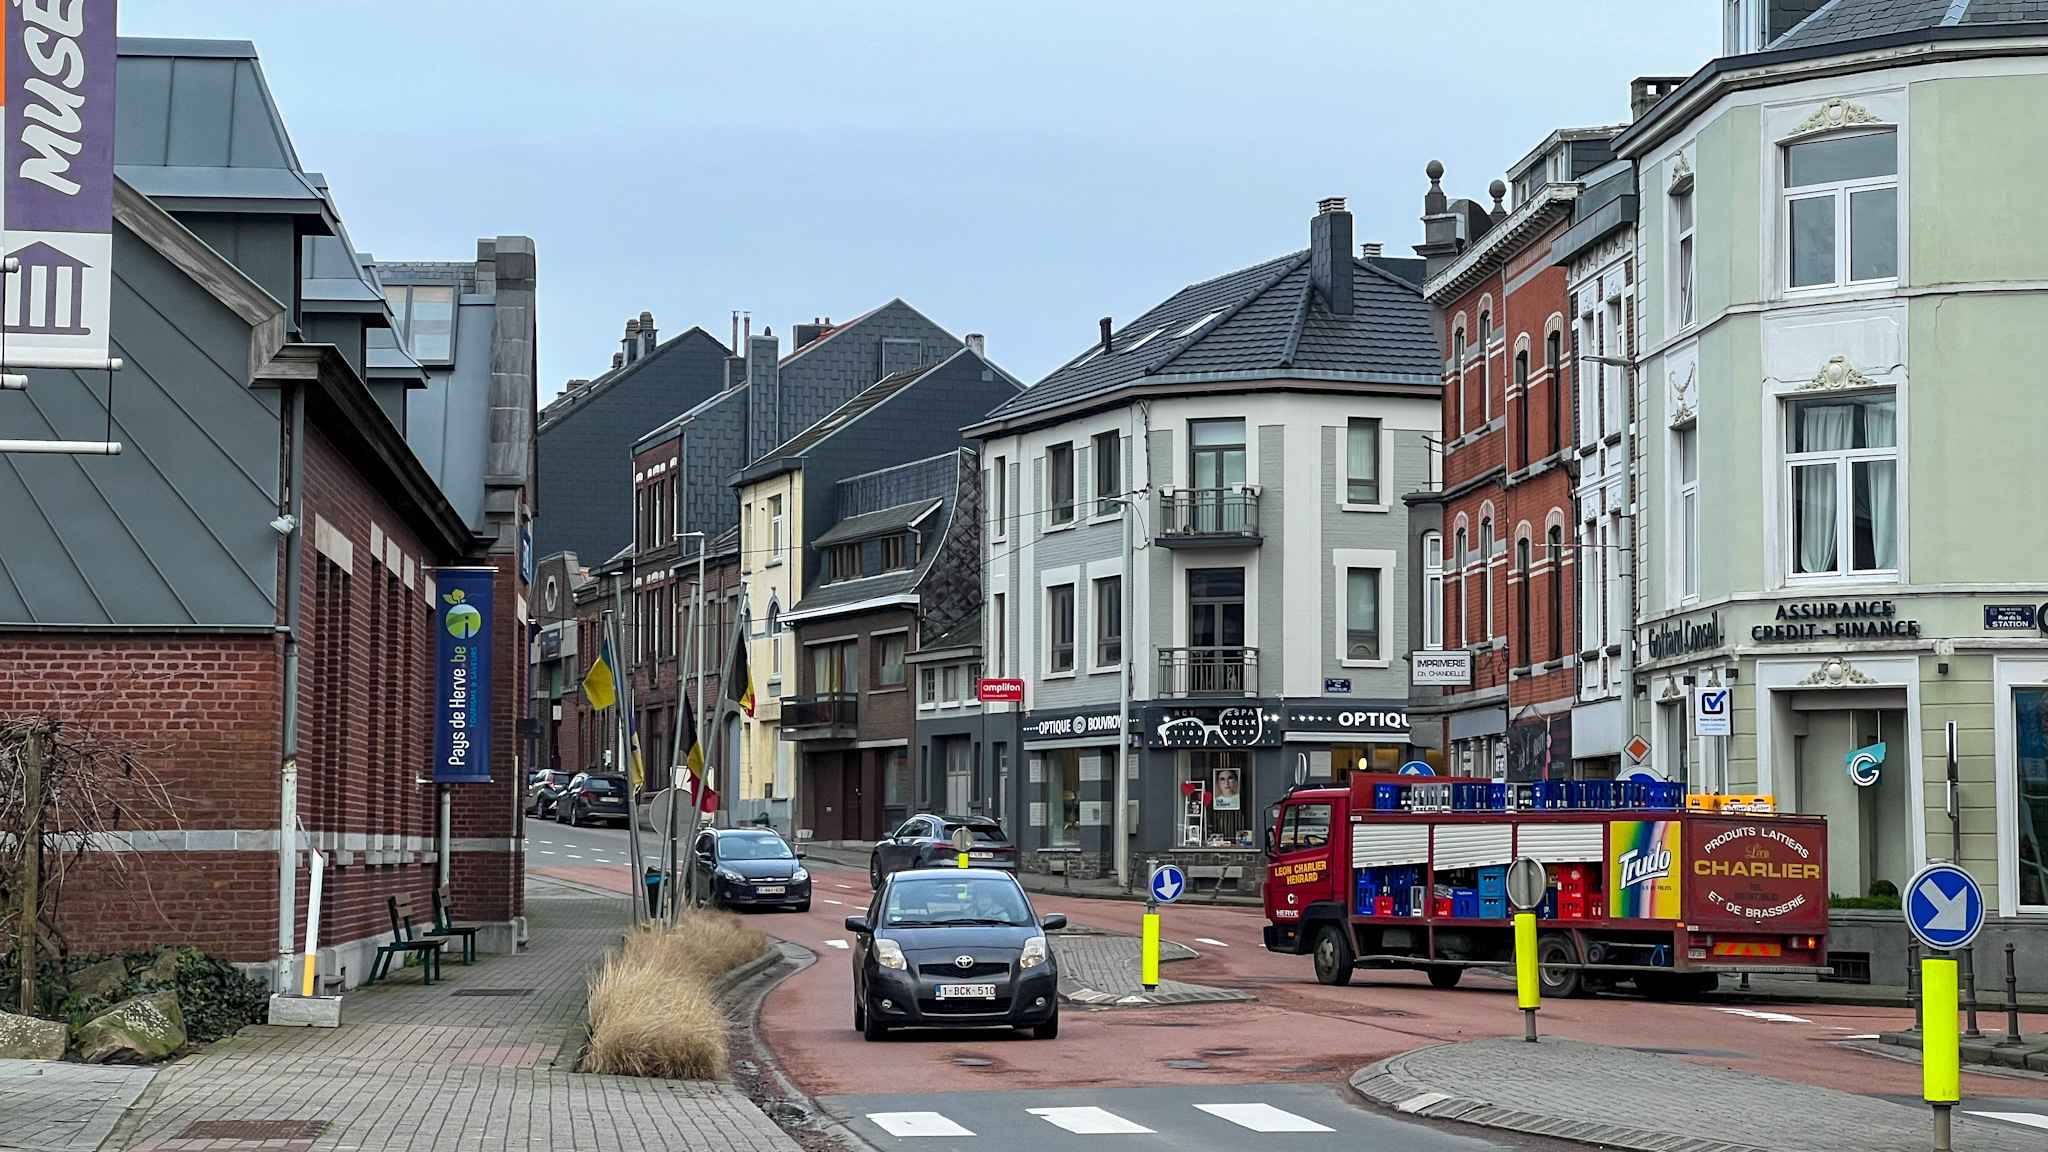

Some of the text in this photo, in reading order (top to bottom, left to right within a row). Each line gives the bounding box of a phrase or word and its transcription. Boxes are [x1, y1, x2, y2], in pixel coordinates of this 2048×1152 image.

[1775, 600, 1893, 620] ASSURANCE
[1752, 623, 1817, 641] CREDIT
[1835, 620, 1917, 638] FINANCE
[1992, 620, 2029, 628] STATION
[1417, 659, 1466, 668] IMPRIMERIE
[983, 682, 1021, 694] amplifon
[449, 711, 466, 729] de
[1038, 719, 1071, 735] OPTIQUE
[448, 731, 470, 766] Pays
[1704, 826, 1810, 859] PRODUITS LAITIERS
[1274, 861, 1327, 877] LEON CHARLIER
[1618, 840, 1671, 890] Trudo
[1694, 859, 1820, 879] CHARLIER
[1286, 872, 1318, 885] HENRARD
[1708, 890, 1725, 905] ET
[1726, 902, 1742, 915] DE
[1745, 894, 1806, 918] BRASSERIE
[1276, 909, 1299, 918] HERVE
